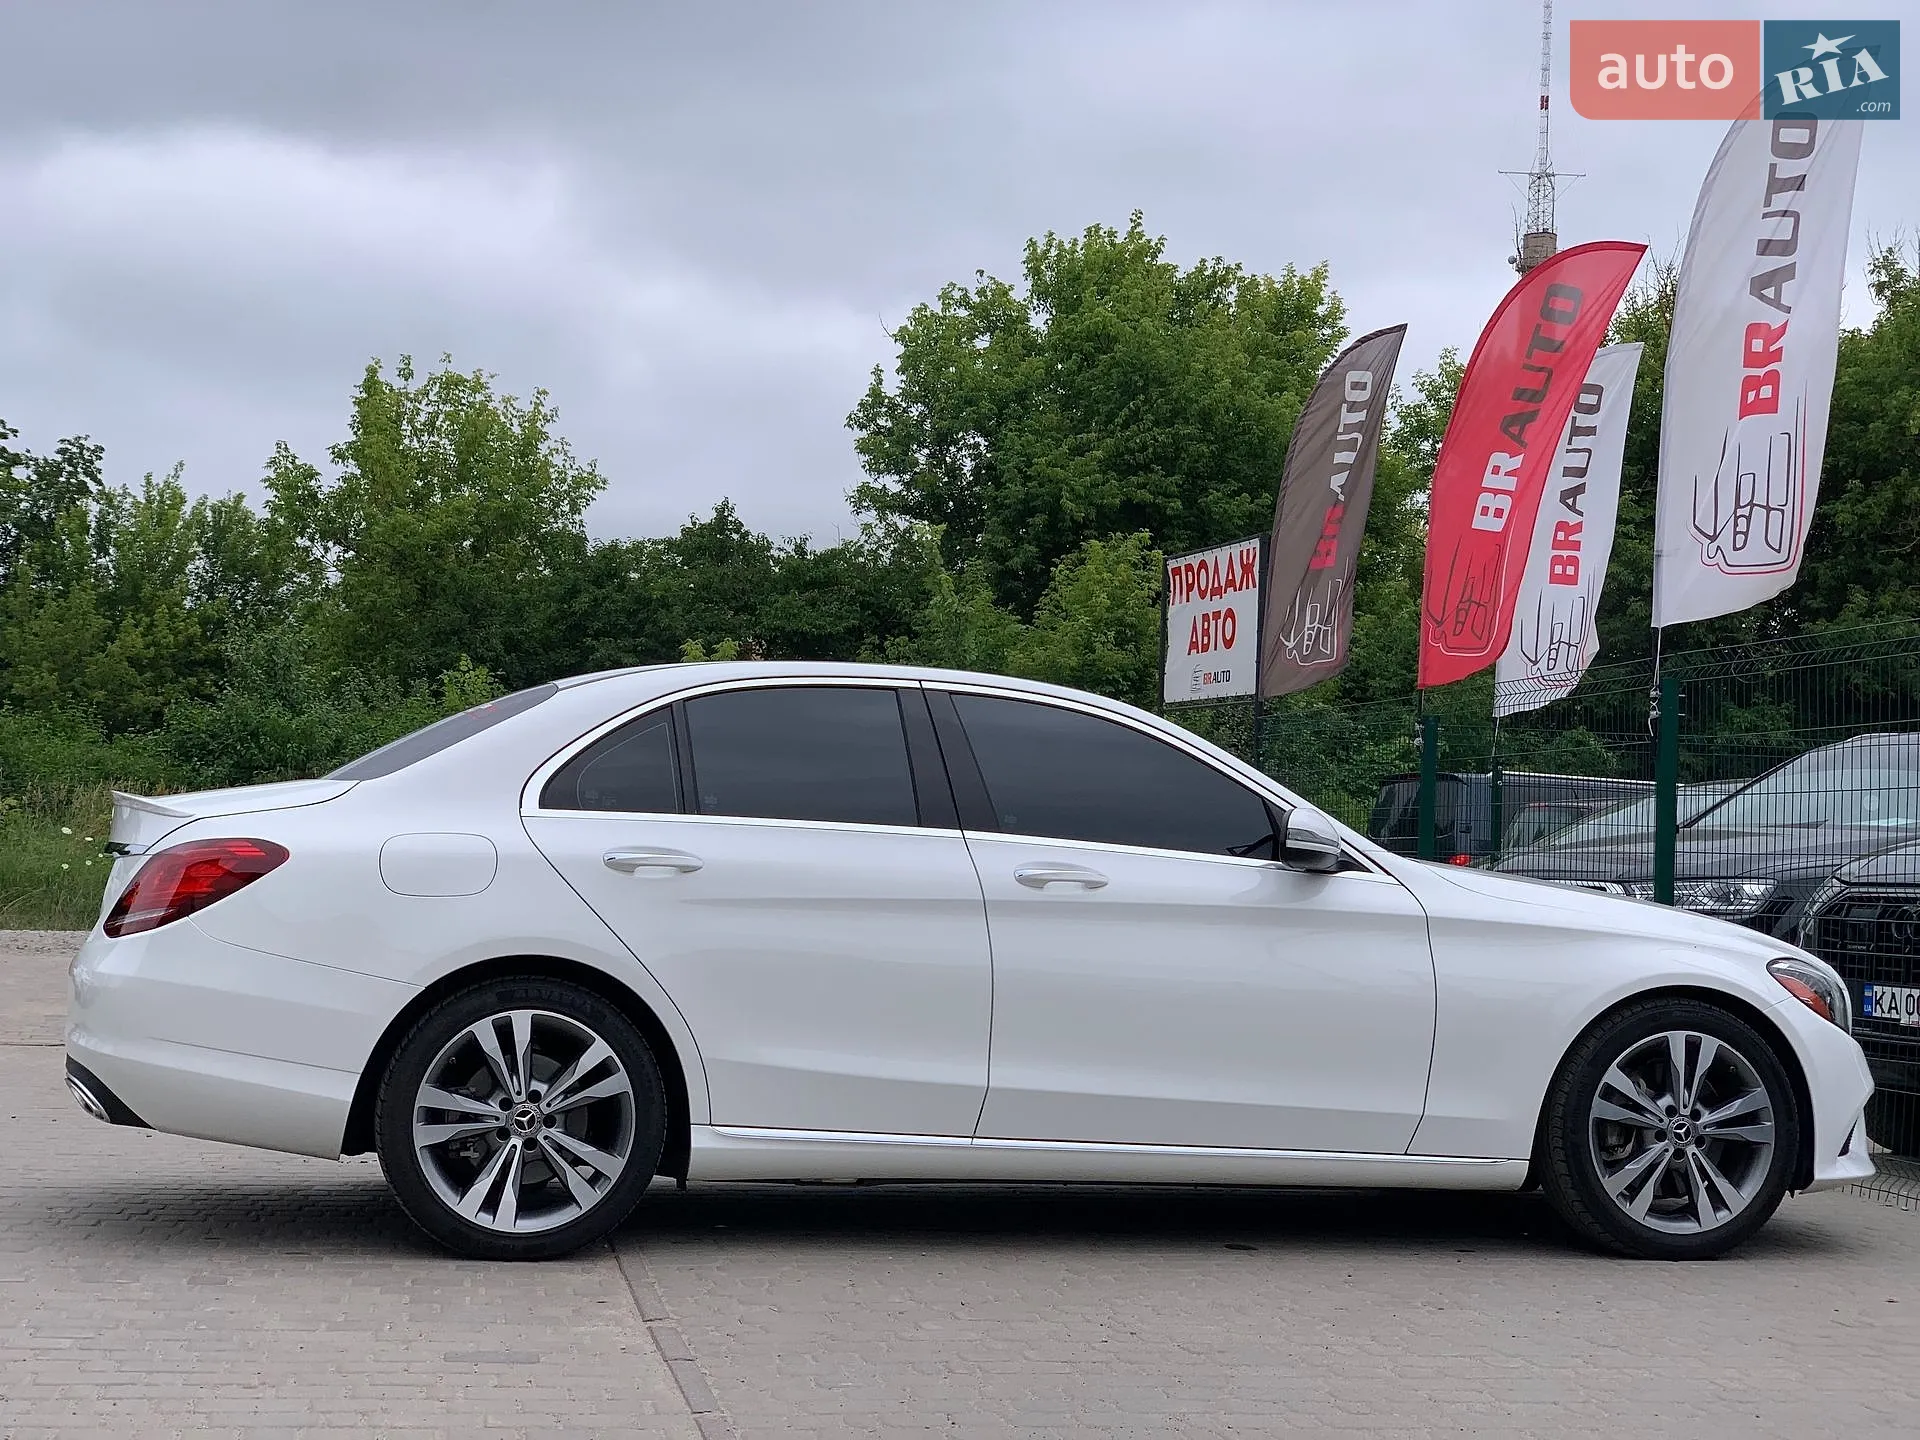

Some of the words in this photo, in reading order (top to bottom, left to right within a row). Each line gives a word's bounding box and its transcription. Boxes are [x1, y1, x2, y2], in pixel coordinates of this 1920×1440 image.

[1738, 112, 1818, 421] BRAUTO
[1472, 283, 1583, 533] BRAUTO
[1548, 383, 1604, 586] BRAUTO
[1170, 547, 1257, 606] ПРОДАЖ
[1187, 607, 1237, 656] АВТО
[1203, 670, 1231, 685] BRAUTO
[1863, 1004, 1872, 1012] UA
[1874, 990, 1900, 1015] KA
